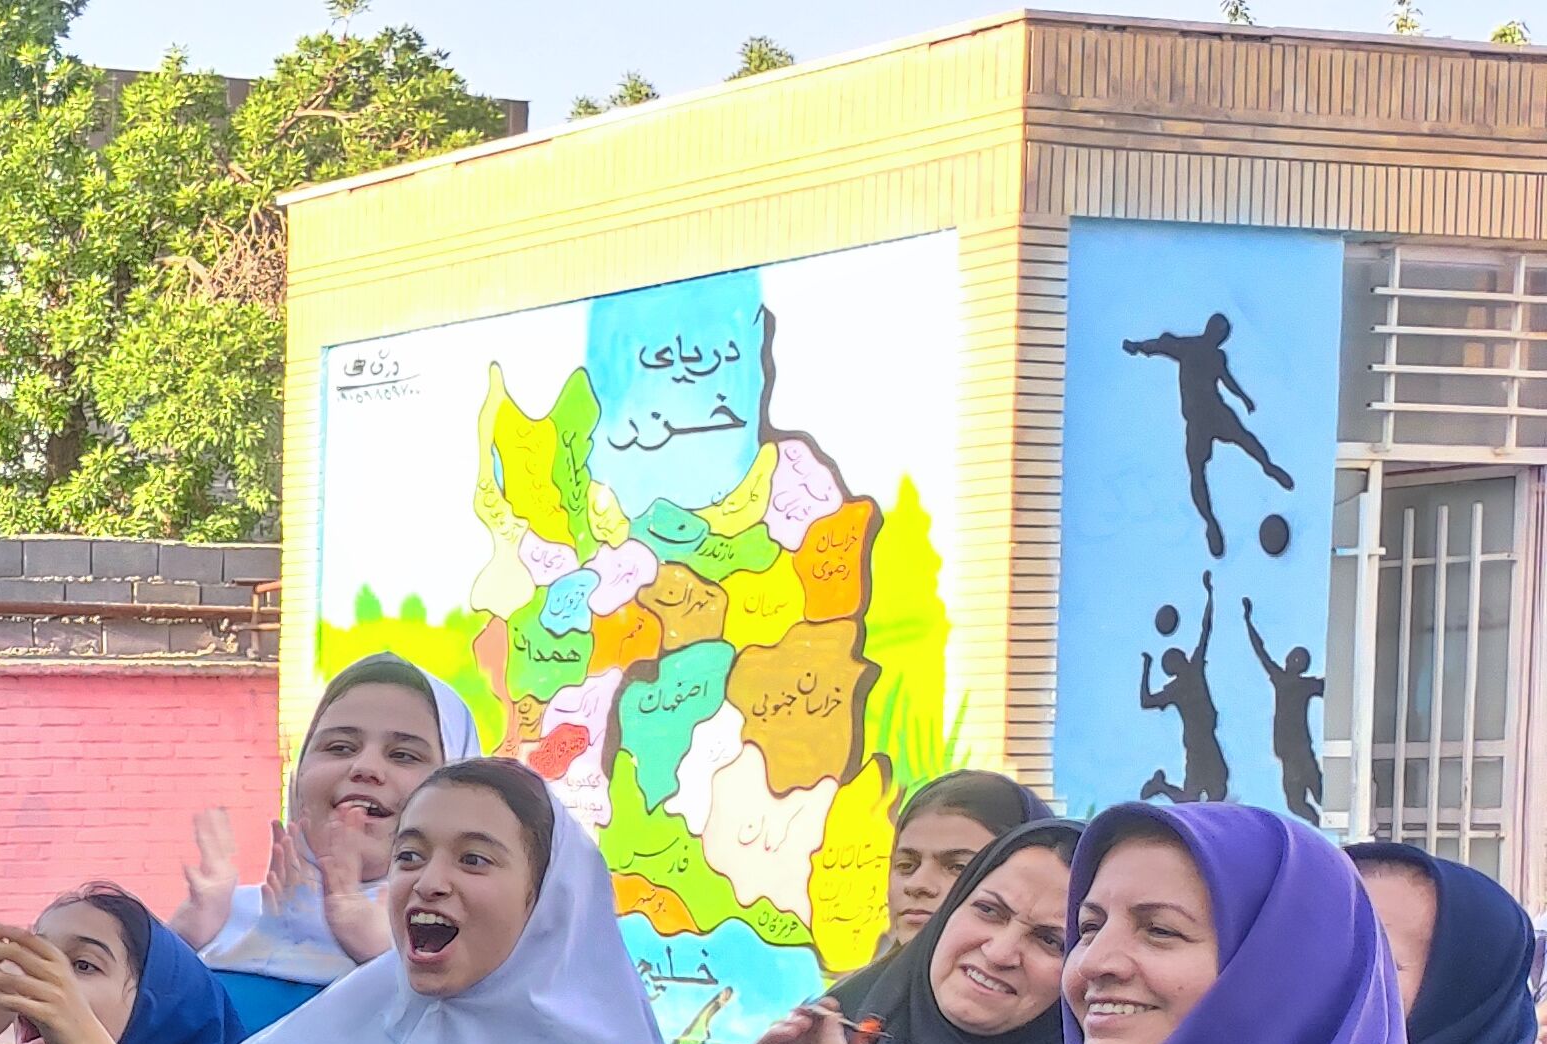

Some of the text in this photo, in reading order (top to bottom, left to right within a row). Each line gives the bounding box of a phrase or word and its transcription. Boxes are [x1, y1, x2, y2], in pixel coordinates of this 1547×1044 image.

[640, 336, 741, 384] دریای
[608, 395, 747, 451] خزر
[816, 524, 858, 553] خراسان
[811, 557, 852, 581] رضوی
[654, 584, 716, 618] تهران
[513, 626, 582, 662] همدان
[554, 684, 600, 719] اراک
[638, 680, 708, 716] اصفهان
[797, 671, 842, 717] خراسان
[737, 803, 805, 853] کرمان
[618, 837, 689, 874] فارس
